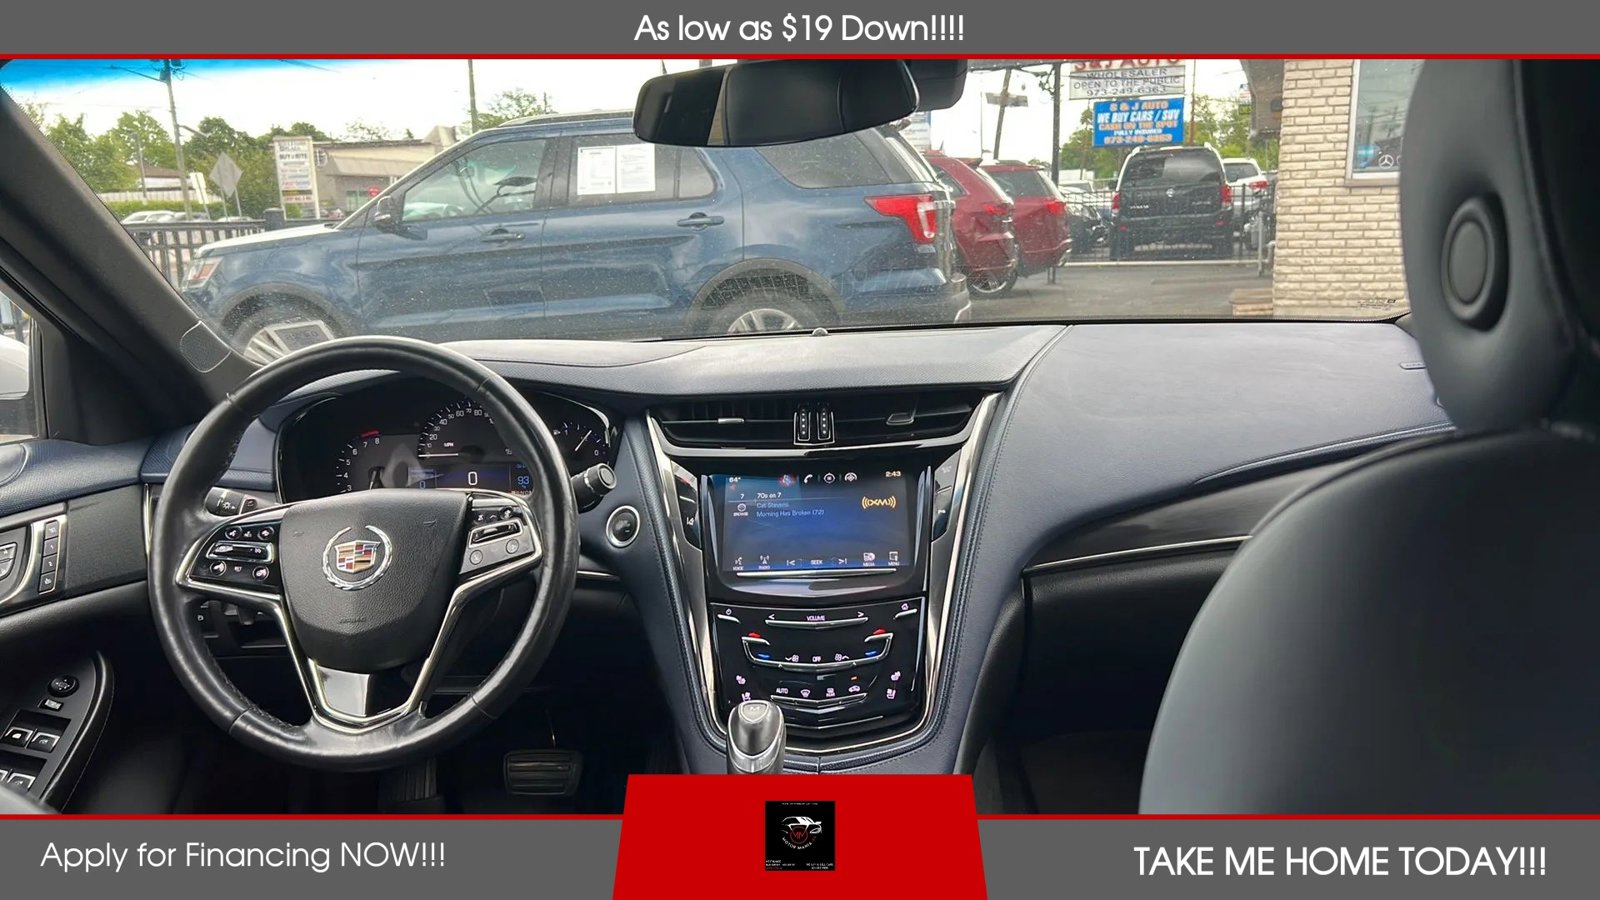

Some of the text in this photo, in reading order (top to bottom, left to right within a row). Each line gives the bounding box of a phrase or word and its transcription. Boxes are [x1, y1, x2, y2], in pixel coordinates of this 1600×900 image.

[1086, 68, 1167, 79] WHOLESALER
[1073, 76, 1180, 90] OPEN TO THE PUBLIC
[1086, 85, 1167, 97] 973-249-6363
[1141, 101, 1169, 110] AUTO
[1097, 112, 1111, 123] WE
[1111, 112, 1130, 122] BUY
[1130, 111, 1154, 121] CARS
[1161, 109, 1180, 119] SUV
[429, 433, 438, 441] 20
[352, 448, 358, 456] 6
[468, 471, 478, 486] 0
[885, 470, 901, 478] 2:43
[517, 475, 530, 485] 93
